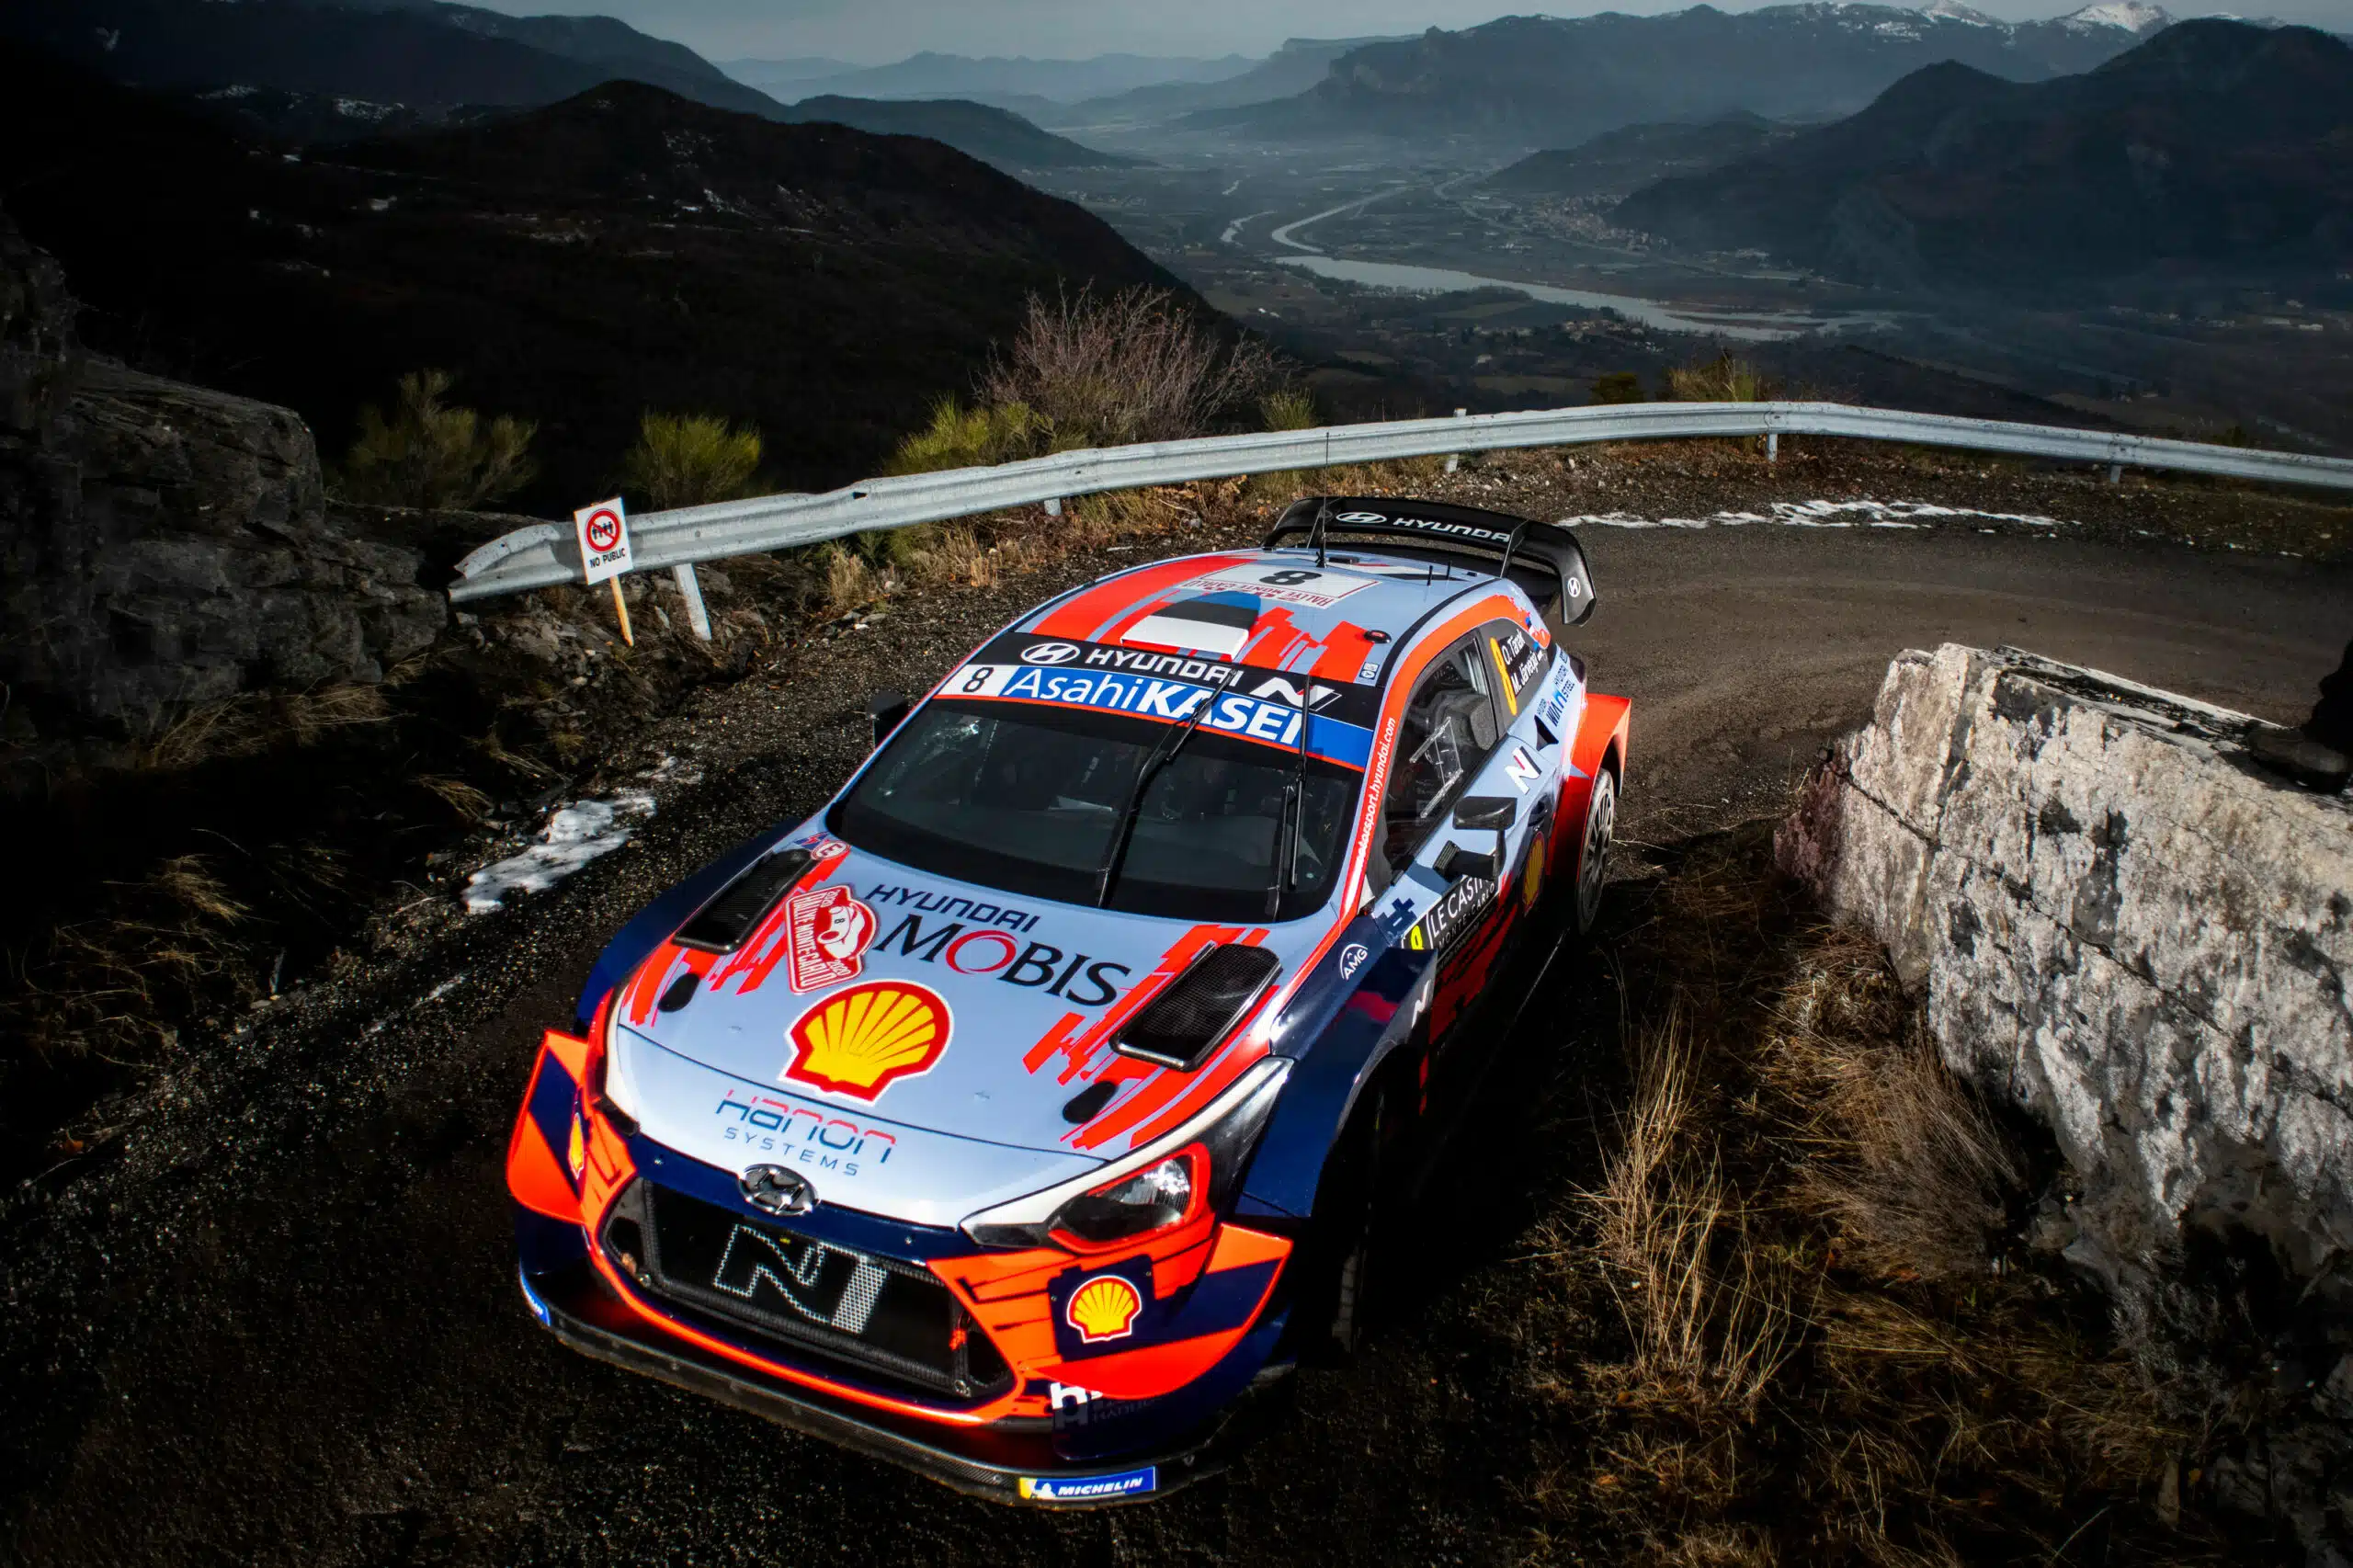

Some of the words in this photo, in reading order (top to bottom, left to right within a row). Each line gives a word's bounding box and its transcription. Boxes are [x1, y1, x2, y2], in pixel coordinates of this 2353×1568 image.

[1392, 517, 1511, 543] HYUNDA
[589, 557, 600, 568] NO
[602, 547, 626, 563] PUBLIC
[1259, 570, 1323, 585] 8
[962, 665, 995, 693] 8
[1085, 648, 1245, 688] HYUNDAI
[863, 883, 1041, 933] HYUNDAI
[1430, 903, 1448, 938] LE
[871, 913, 1132, 1006] MOBIS
[1343, 948, 1369, 982] AMG
[723, 1126, 860, 1177] SYSTEMS
[1057, 1476, 1143, 1496] MICHELIN
